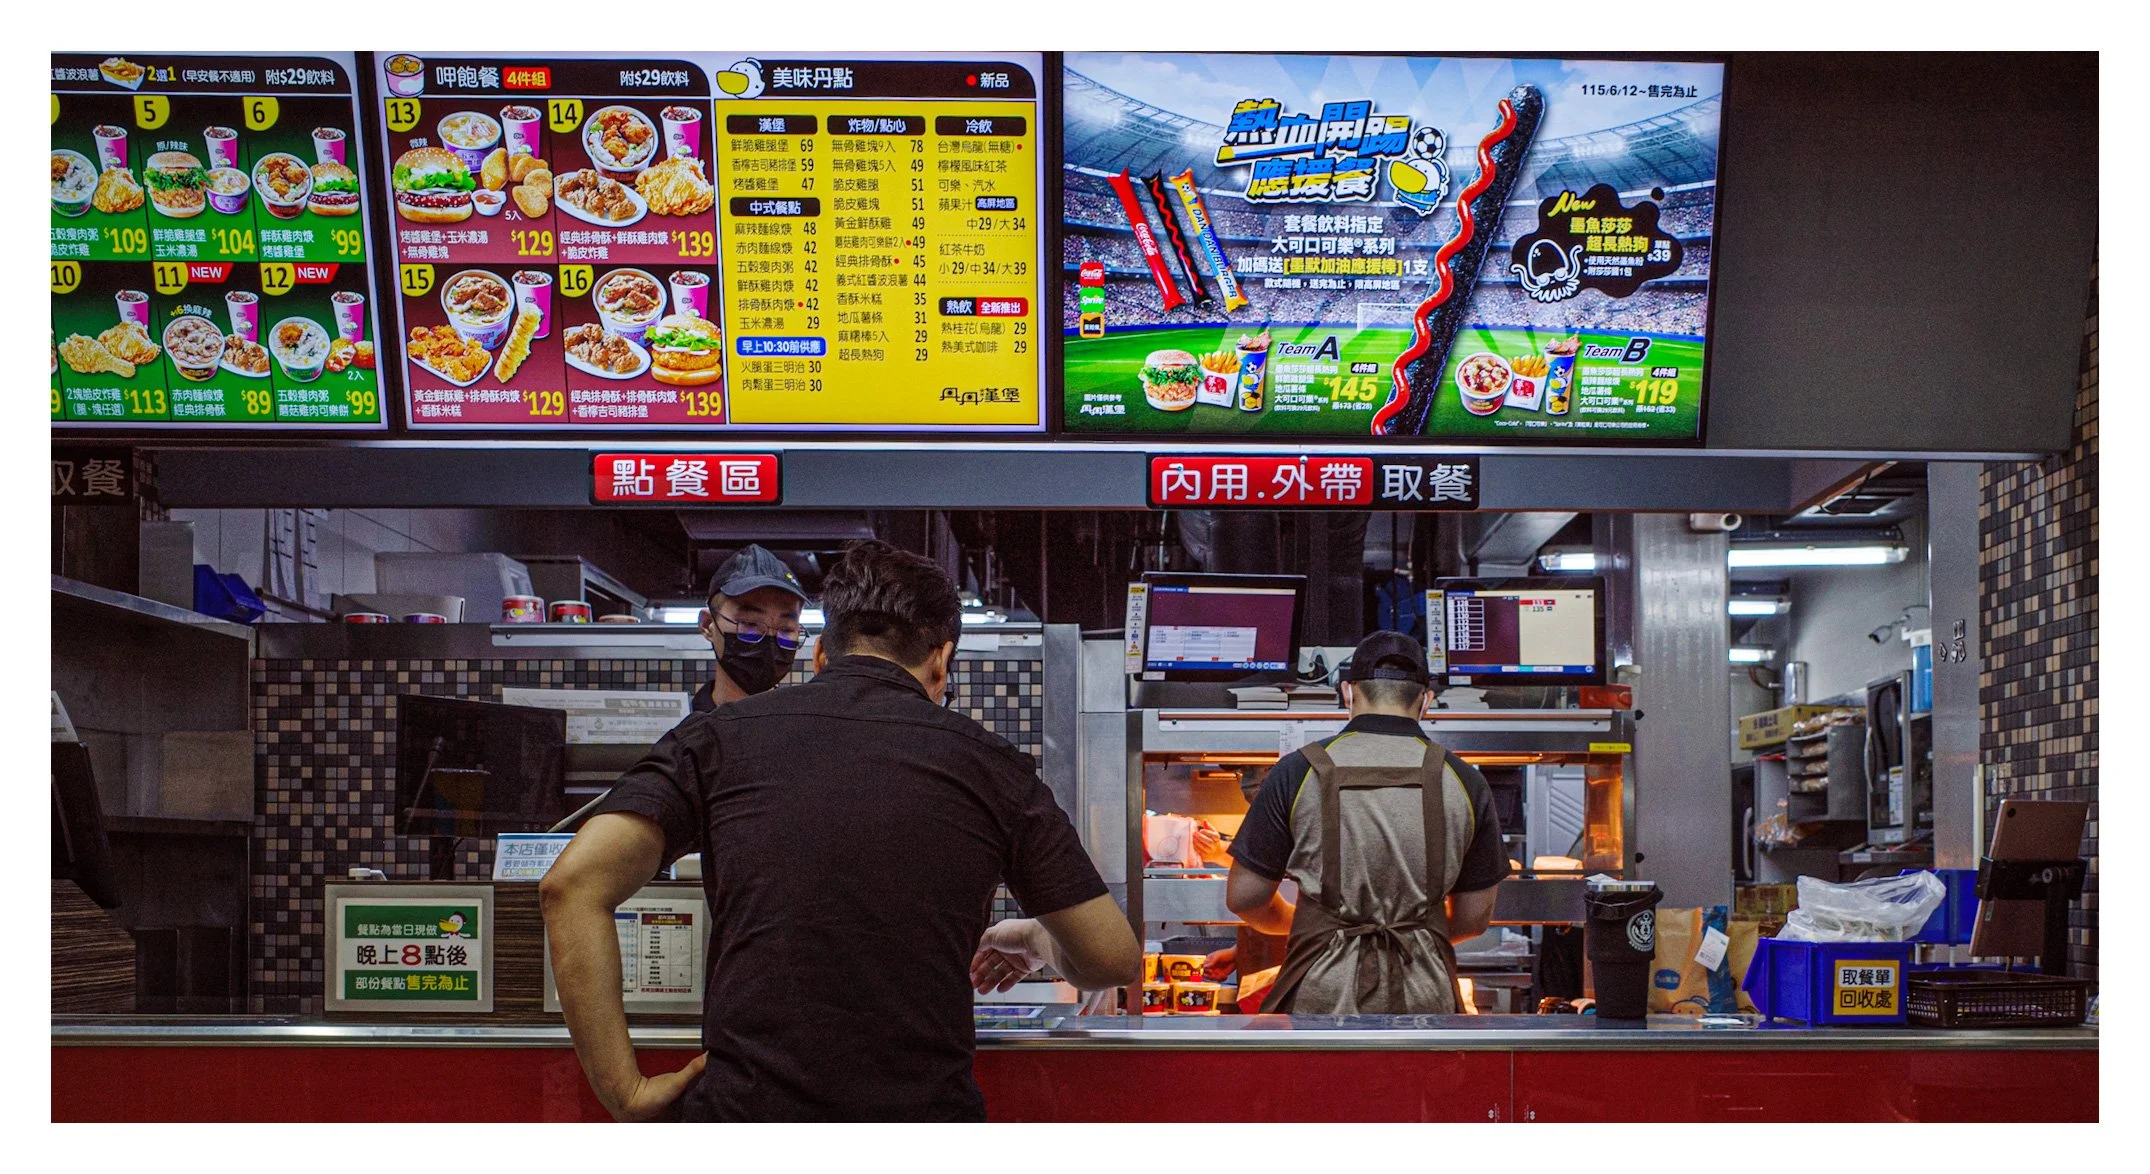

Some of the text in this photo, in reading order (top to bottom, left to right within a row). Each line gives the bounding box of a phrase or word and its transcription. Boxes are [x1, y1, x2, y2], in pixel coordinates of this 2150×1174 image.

[147, 66, 177, 82] 2選1
[266, 69, 335, 85] 附$29飲料
[436, 66, 689, 88] 呷飽餐 4件組 附$29飲料
[773, 68, 1009, 89] 美味丹點 新品
[1582, 85, 1697, 98] 115/6/12~售完為止
[145, 101, 156, 121] 5
[253, 102, 265, 123] 6
[391, 102, 415, 123] 13
[553, 103, 578, 124] 14
[758, 118, 785, 133] 漢堡
[848, 119, 906, 133] 炸物/點心
[966, 120, 992, 134] 冷飲
[800, 139, 813, 152] 69
[832, 140, 923, 153] 無骨雞塊9入 78
[801, 159, 814, 172] 59
[832, 159, 924, 173] 無骨雞塊5入 49
[938, 160, 1007, 173] 檸檬風味紅茶
[802, 178, 814, 191] 47
[833, 179, 924, 192] 脆皮雞腿 51
[938, 179, 995, 192] 可樂、汽水
[1247, 158, 1376, 199] 應援餐
[750, 201, 801, 216] 中式餐點
[834, 198, 924, 211] 脆皮雞塊 51
[939, 199, 972, 212] 蘋果汁
[1548, 191, 1595, 217] New
[505, 210, 522, 221] 5入
[803, 223, 816, 237] 48
[912, 217, 925, 230] 49
[1284, 215, 1383, 234] 套餐飲料指定
[104, 227, 147, 253] $109
[211, 228, 255, 254] $104
[330, 229, 361, 256] $99
[511, 230, 554, 256] $129
[672, 231, 714, 257] $139
[913, 236, 926, 250] 49
[1586, 236, 1649, 252] 超長熱狗
[155, 245, 199, 257] 玉米濃湯
[402, 246, 449, 259] +無骨雞塊
[562, 247, 608, 260] +脆皮炸雞
[803, 242, 817, 256] 42
[940, 244, 985, 256] 紅茶牛奶
[1193, 209, 1237, 298] DAN DAN BURGER
[1647, 250, 1671, 262] $39
[804, 261, 817, 274] 42
[913, 255, 926, 268] 45
[51, 265, 76, 286] 10
[158, 266, 184, 287] 11
[191, 267, 222, 278] NEW
[264, 267, 289, 288] 12
[298, 268, 328, 279] NEW
[405, 268, 428, 289] 15
[564, 269, 587, 290] 16
[805, 279, 818, 293] 42
[914, 274, 926, 287] 44
[806, 298, 819, 311] 42
[837, 293, 926, 306] 香酥米糕 35
[1081, 296, 1104, 305] Sprite
[946, 300, 1021, 314] 熱飲 全新推出
[739, 317, 820, 330] 玉米濃湯 29
[838, 312, 927, 325] 地瓜薯條 31
[1014, 322, 1026, 335] 29
[915, 330, 927, 343] 29
[742, 340, 821, 354] 早上10:30前供應
[941, 341, 1026, 354] 熱美式咖啡 29
[839, 349, 928, 362] 超長熱狗 29
[741, 361, 821, 374] 火腿蛋三明治 30
[1352, 363, 1377, 373] 4件組
[1652, 368, 1677, 377] 4件組
[348, 370, 364, 381] 2入
[742, 379, 822, 392] 肉鬆蛋三明治 30
[1323, 376, 1378, 401] $145
[1629, 380, 1678, 405] $119
[67, 387, 120, 400] 2塊脆皮炸雞
[278, 390, 329, 402] 五穀瘦肉粥
[939, 387, 1021, 405] 丹丹漢堡
[124, 389, 167, 415] $113
[241, 390, 271, 415] $89
[346, 390, 375, 416] $99
[523, 390, 564, 416] $129
[680, 391, 722, 417] $139
[173, 404, 226, 416] 經典排骨酥
[415, 404, 462, 418] +香酥米糕
[612, 459, 763, 498] 點餐區
[1161, 462, 1473, 501] 內用.外帶 取餐
[357, 923, 437, 937] 餐點為當日現做
[356, 944, 468, 967] 晚上8點後
[355, 974, 470, 992] 部份餐點售完為止
[1841, 968, 1891, 985] 取餐單
[1840, 990, 1893, 1009] 回收處
